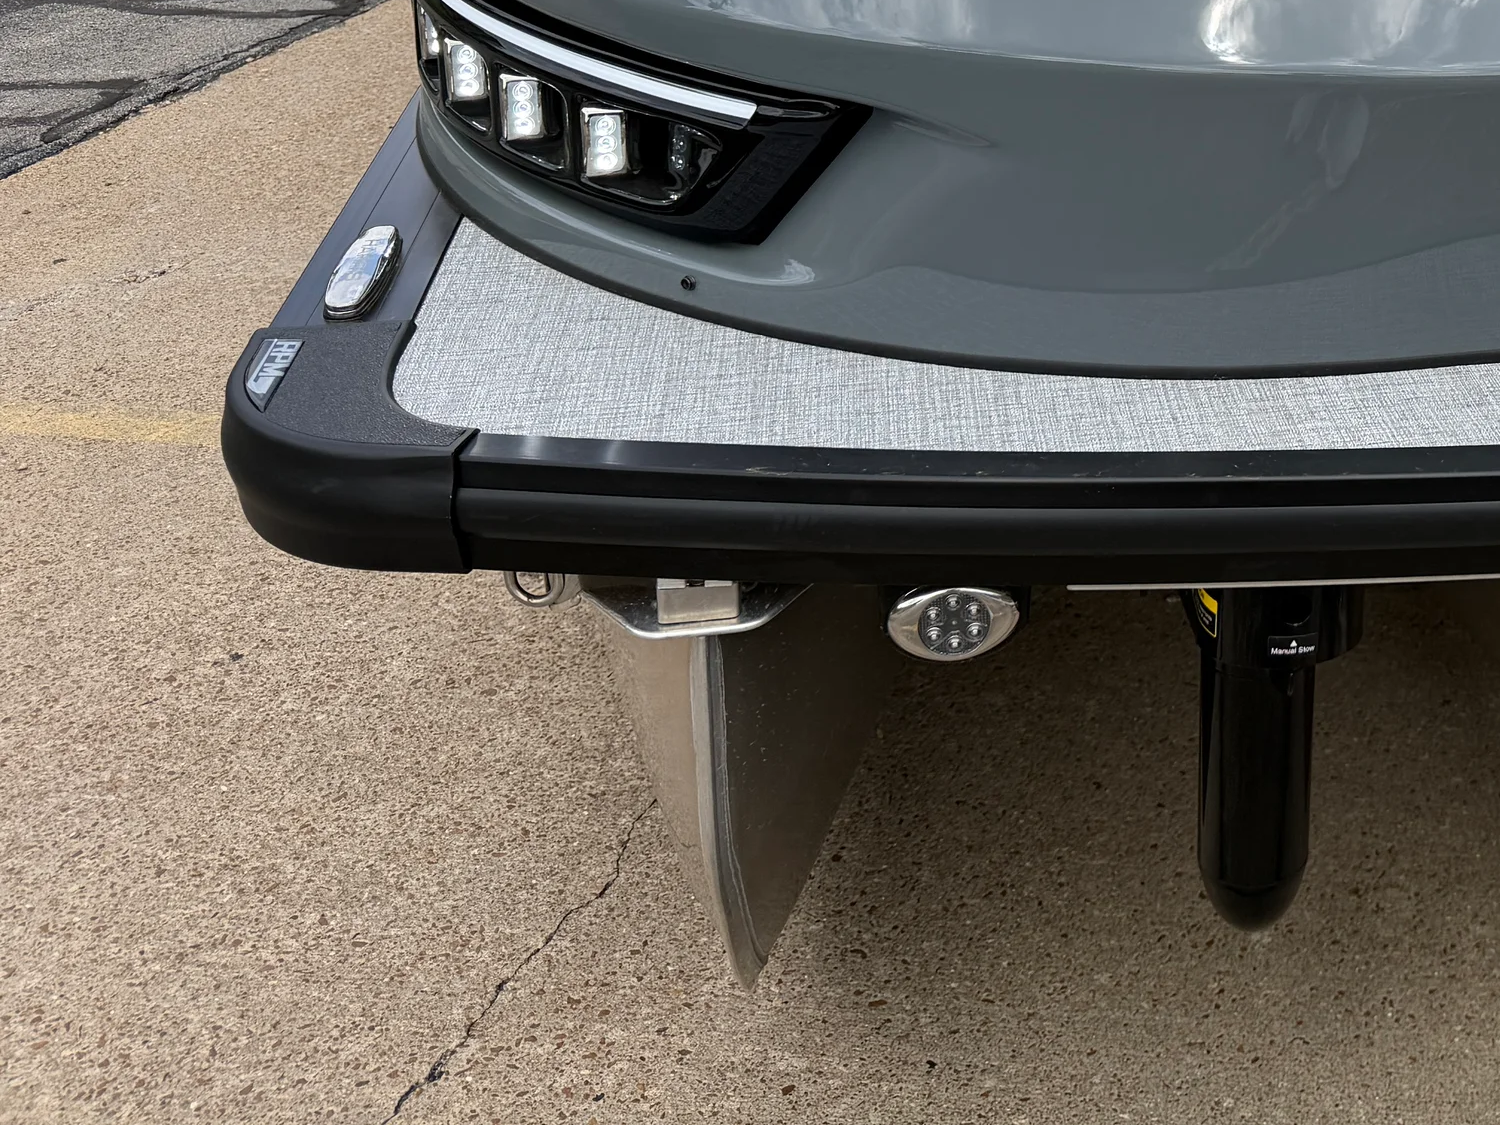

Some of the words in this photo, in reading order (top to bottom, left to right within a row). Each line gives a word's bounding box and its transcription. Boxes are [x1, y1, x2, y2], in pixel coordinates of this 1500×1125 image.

[258, 341, 301, 377] RPM
[1270, 646, 1297, 655] Manual
[1297, 645, 1316, 654] Stow
